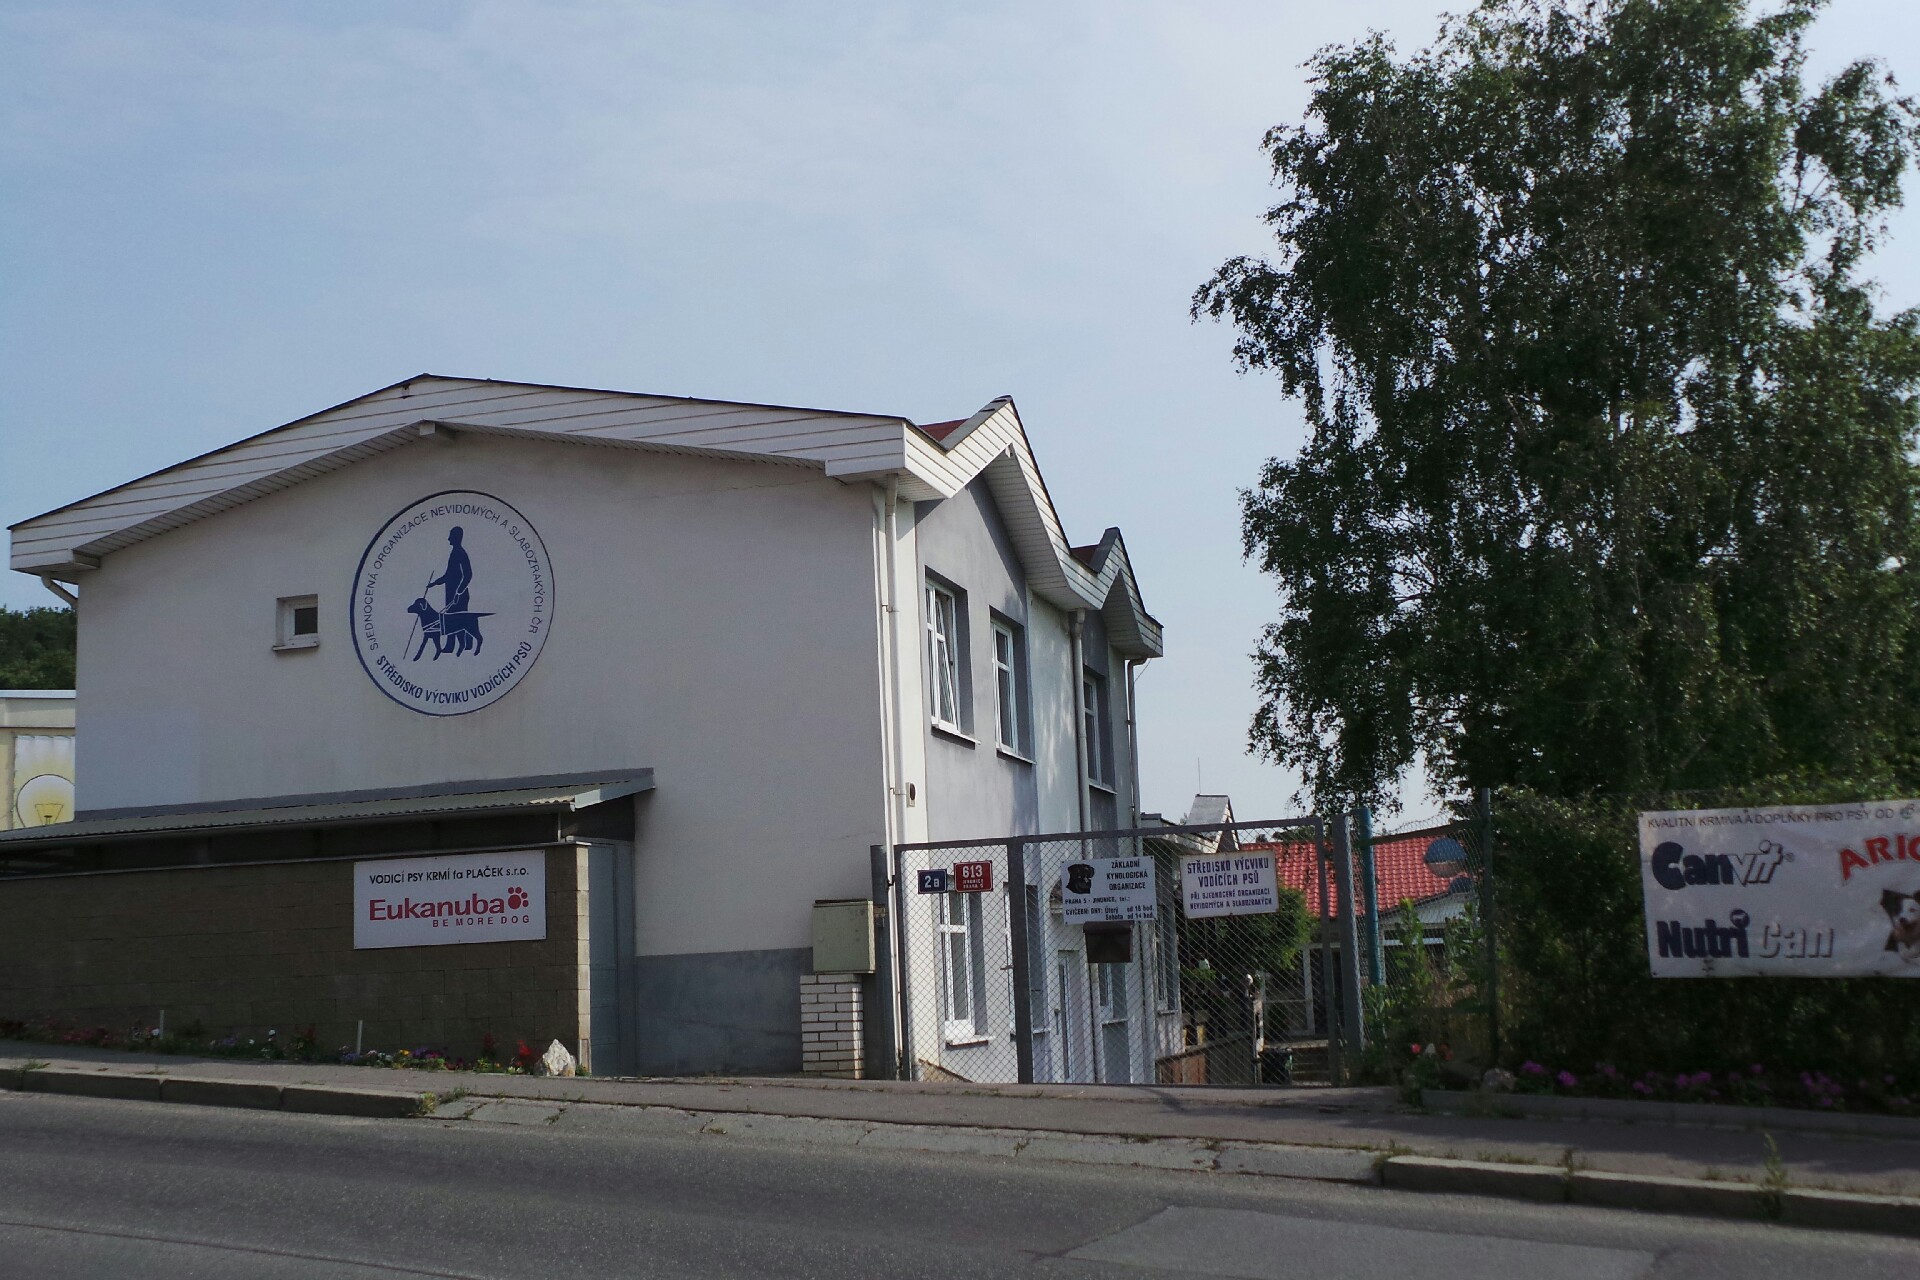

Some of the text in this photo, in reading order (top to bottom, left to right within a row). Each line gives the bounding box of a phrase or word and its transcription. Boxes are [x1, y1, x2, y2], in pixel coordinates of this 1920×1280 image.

[363, 504, 545, 651] SJEDNOCENÁ ORGANIZACE NEVIDOMÝCH A SLABOZRAKÝCH ČR
[376, 641, 533, 704] STŘEDISKO VÝCVIKU VODÍCÍCH PSŮ
[1815, 811, 1843, 822] PRO
[1847, 809, 1871, 820] PSY
[1875, 808, 1894, 819] OD
[1111, 858, 1140, 869] ZÁKLADNÍ
[1187, 857, 1269, 874] STŘEDISKO VÝCVIKU
[1652, 839, 1784, 890] Canvit
[369, 865, 529, 884] VODICÍ PSY KRMÍ fa PLAČEK s.r.o.
[962, 864, 983, 878] 613
[1106, 869, 1148, 880] KYNOLOGICKÁ
[1198, 870, 1259, 888] VODÍCÍCH PSŮ
[1109, 882, 1146, 891] ORGANIZACE
[1191, 888, 1270, 900] PŘI SJEDNOCENÉ ORGANIZACI
[369, 893, 505, 921] Eukanuba
[1105, 905, 1119, 914] Úterý
[1190, 900, 1224, 910] NEVIDOMÝCH
[1232, 897, 1272, 907] SLABOZRAKÝCH
[432, 915, 530, 928] BE MORE DOG
